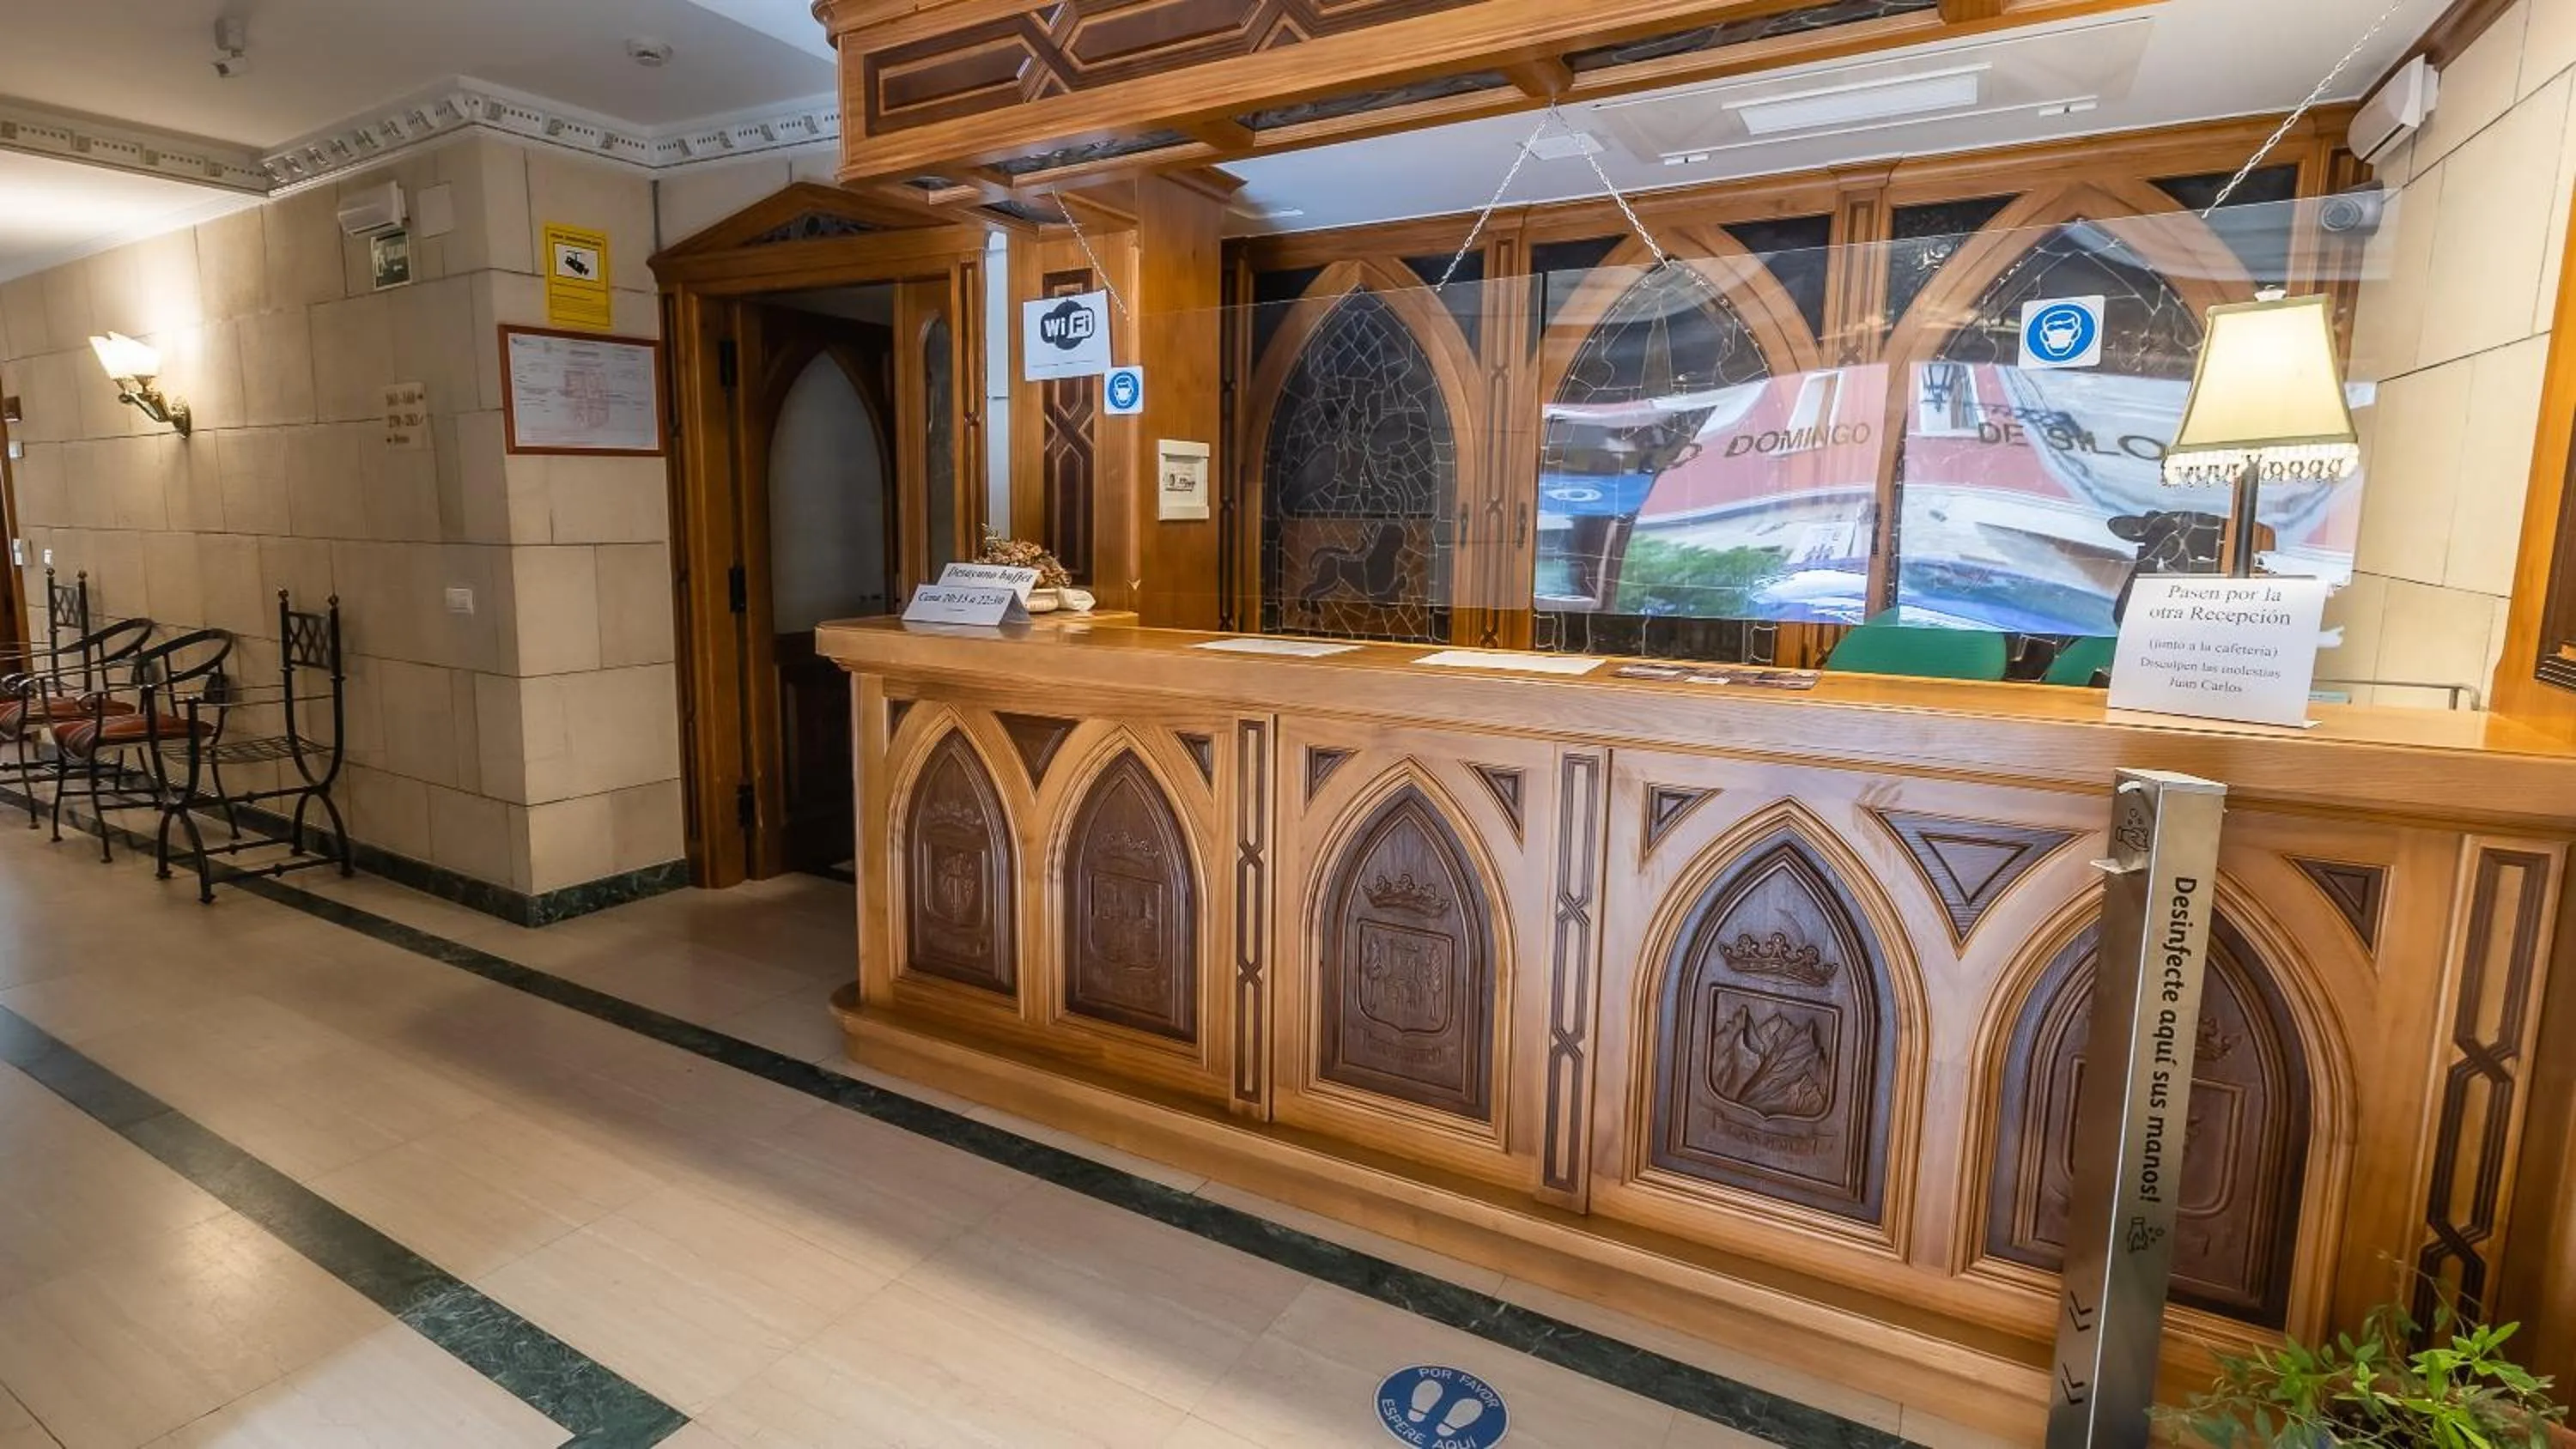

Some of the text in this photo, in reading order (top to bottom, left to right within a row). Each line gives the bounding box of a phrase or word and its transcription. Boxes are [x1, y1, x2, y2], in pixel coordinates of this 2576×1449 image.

[1724, 422, 1871, 458] DOMINGO
[1978, 422, 2024, 445] DE
[947, 567, 1033, 585] Desayuno buffet
[2167, 585, 2281, 603] Pasen por la
[2149, 606, 2291, 627] otra Recepción
[2200, 640, 2212, 652] la
[2141, 657, 2281, 678] Disculpen las molestias
[2169, 677, 2244, 694] Juan Carlos
[2139, 876, 2197, 1203] Desinfecte aquí sus manos!
[1418, 1367, 1500, 1409] POR FAVOR
[1381, 1398, 1426, 1445] ESPERE
